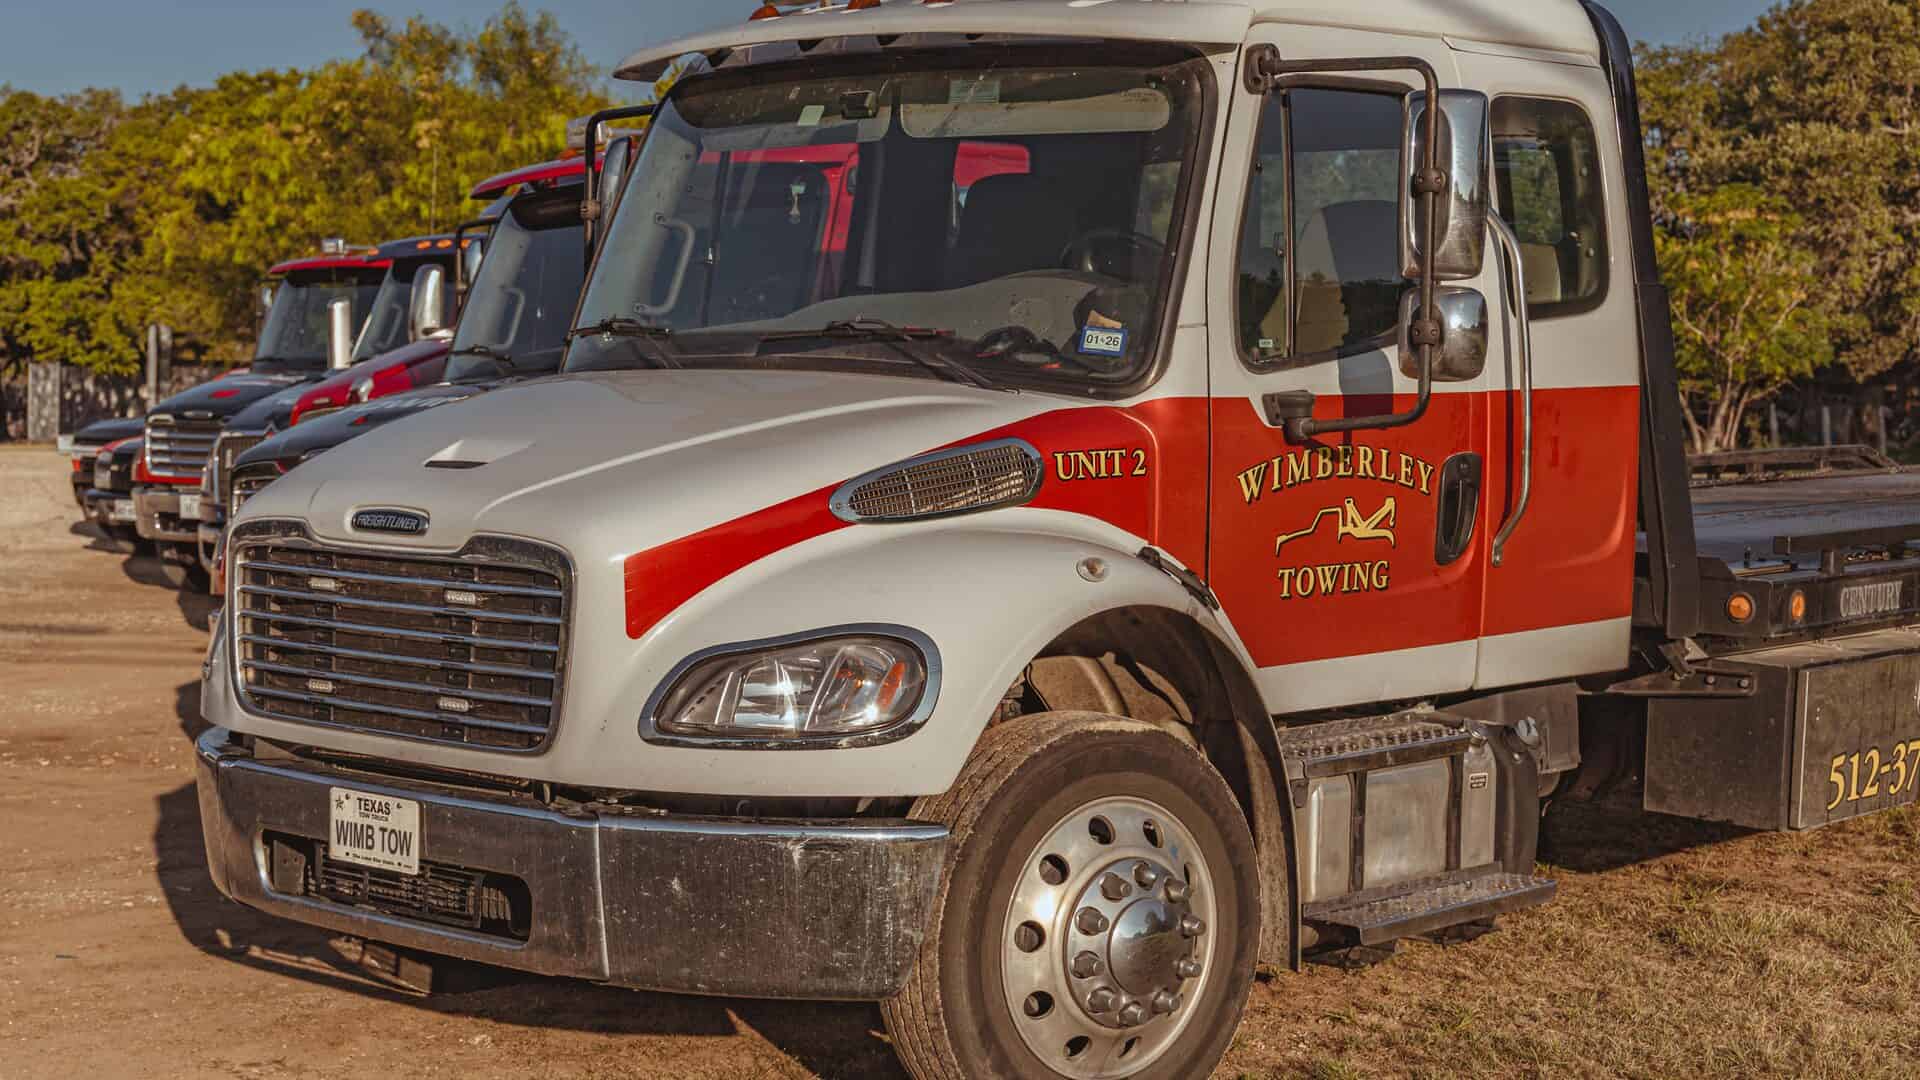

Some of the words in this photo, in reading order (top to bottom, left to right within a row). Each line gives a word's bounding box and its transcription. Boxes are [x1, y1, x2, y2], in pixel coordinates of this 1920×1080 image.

[1053, 449, 1126, 481] UNIT
[1130, 449, 1147, 477] 2
[1237, 445, 1434, 503] WIMBERLEY
[355, 513, 418, 530] FREIGHTLINER
[1278, 560, 1390, 599] TOWING
[1840, 580, 1904, 618] CENTURY
[1827, 740, 1920, 811] 512-37
[357, 797, 392, 816] TEXAS
[336, 819, 375, 850] WIMB
[379, 827, 413, 857] TOW
